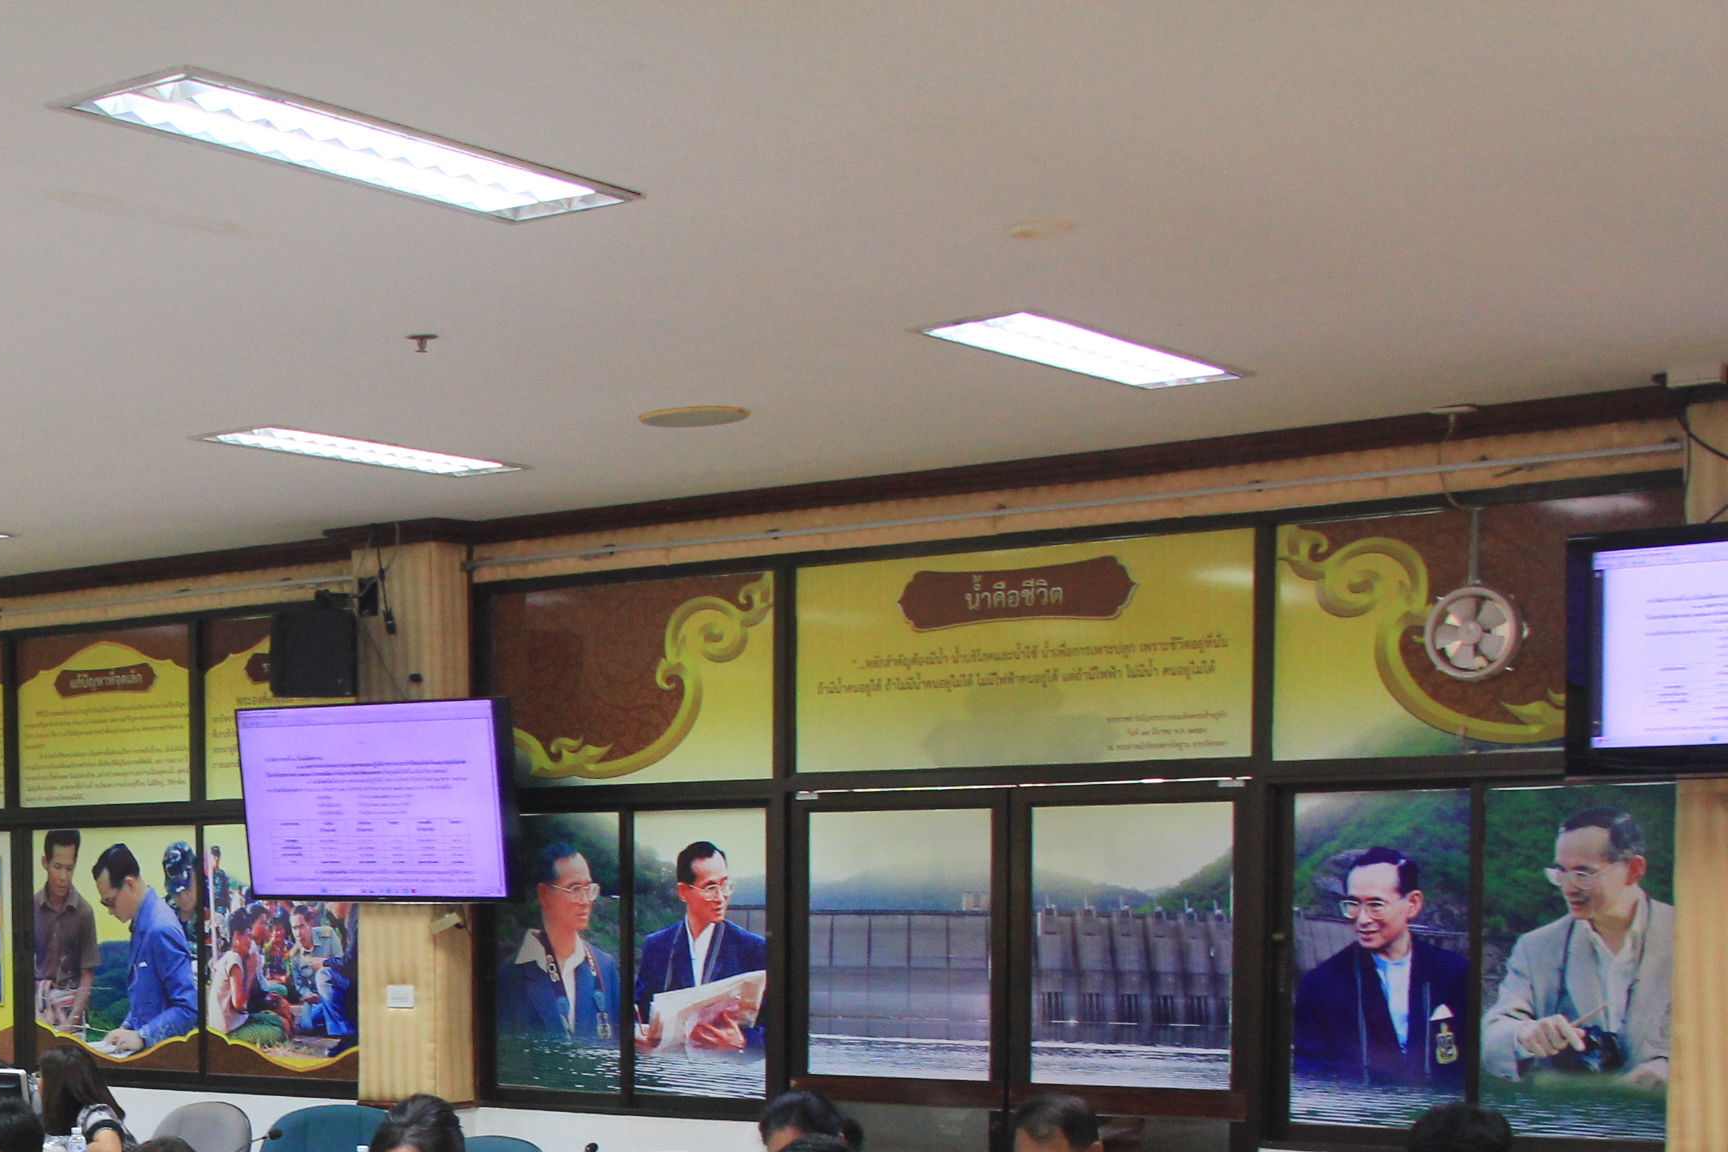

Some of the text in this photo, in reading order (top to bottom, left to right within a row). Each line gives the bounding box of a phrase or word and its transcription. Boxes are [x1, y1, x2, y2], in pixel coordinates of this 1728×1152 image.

[965, 574, 1064, 611] น้ำคือชีวิต
